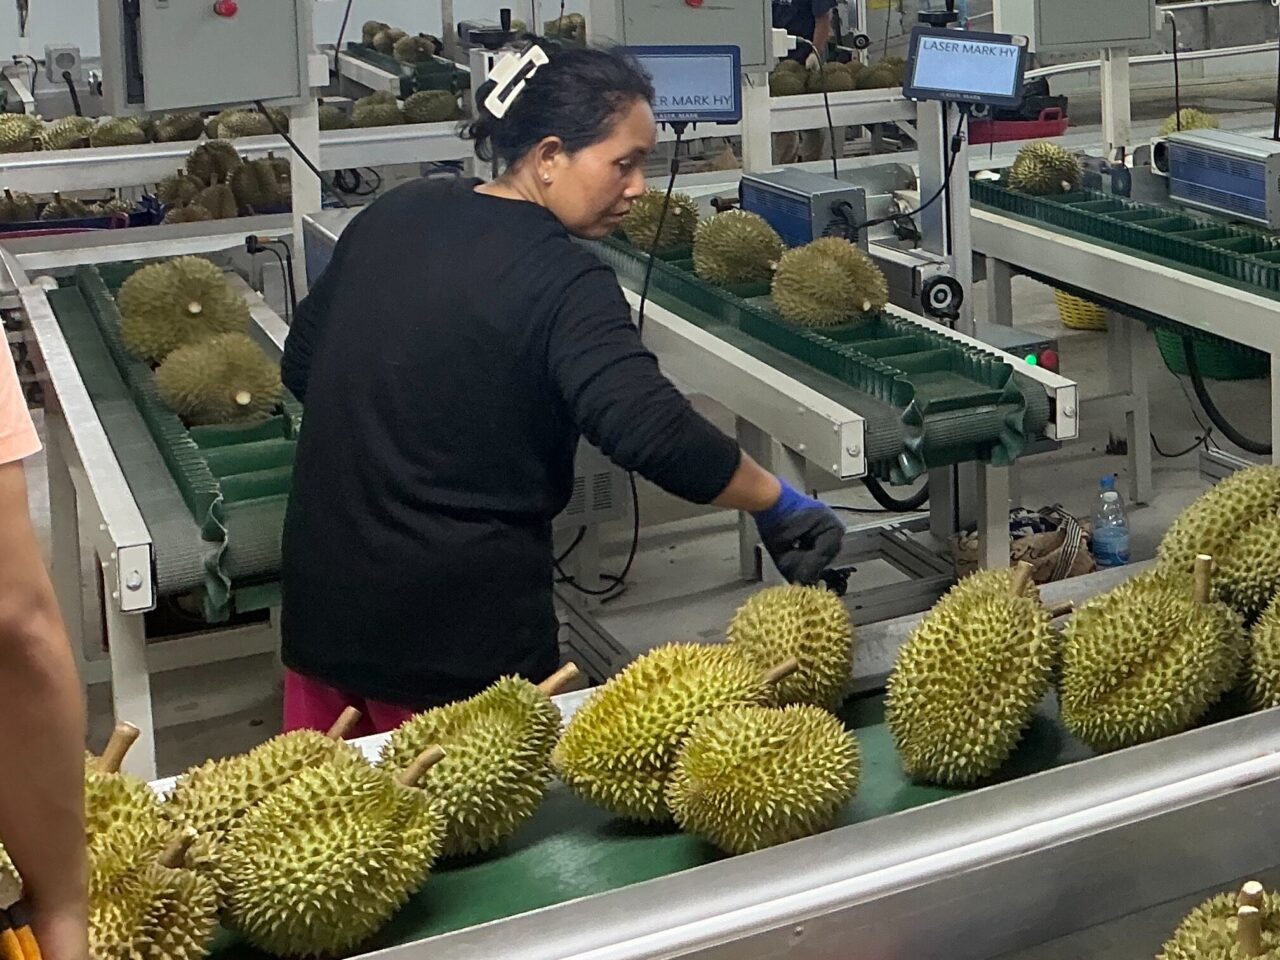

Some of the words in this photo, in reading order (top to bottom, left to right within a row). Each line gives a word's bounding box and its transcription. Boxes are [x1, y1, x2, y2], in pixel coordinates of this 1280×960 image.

[923, 40, 960, 51] LASER
[962, 44, 997, 56] MARK
[999, 47, 1017, 57] HY
[672, 95, 710, 106] MARK
[713, 95, 731, 105] HY
